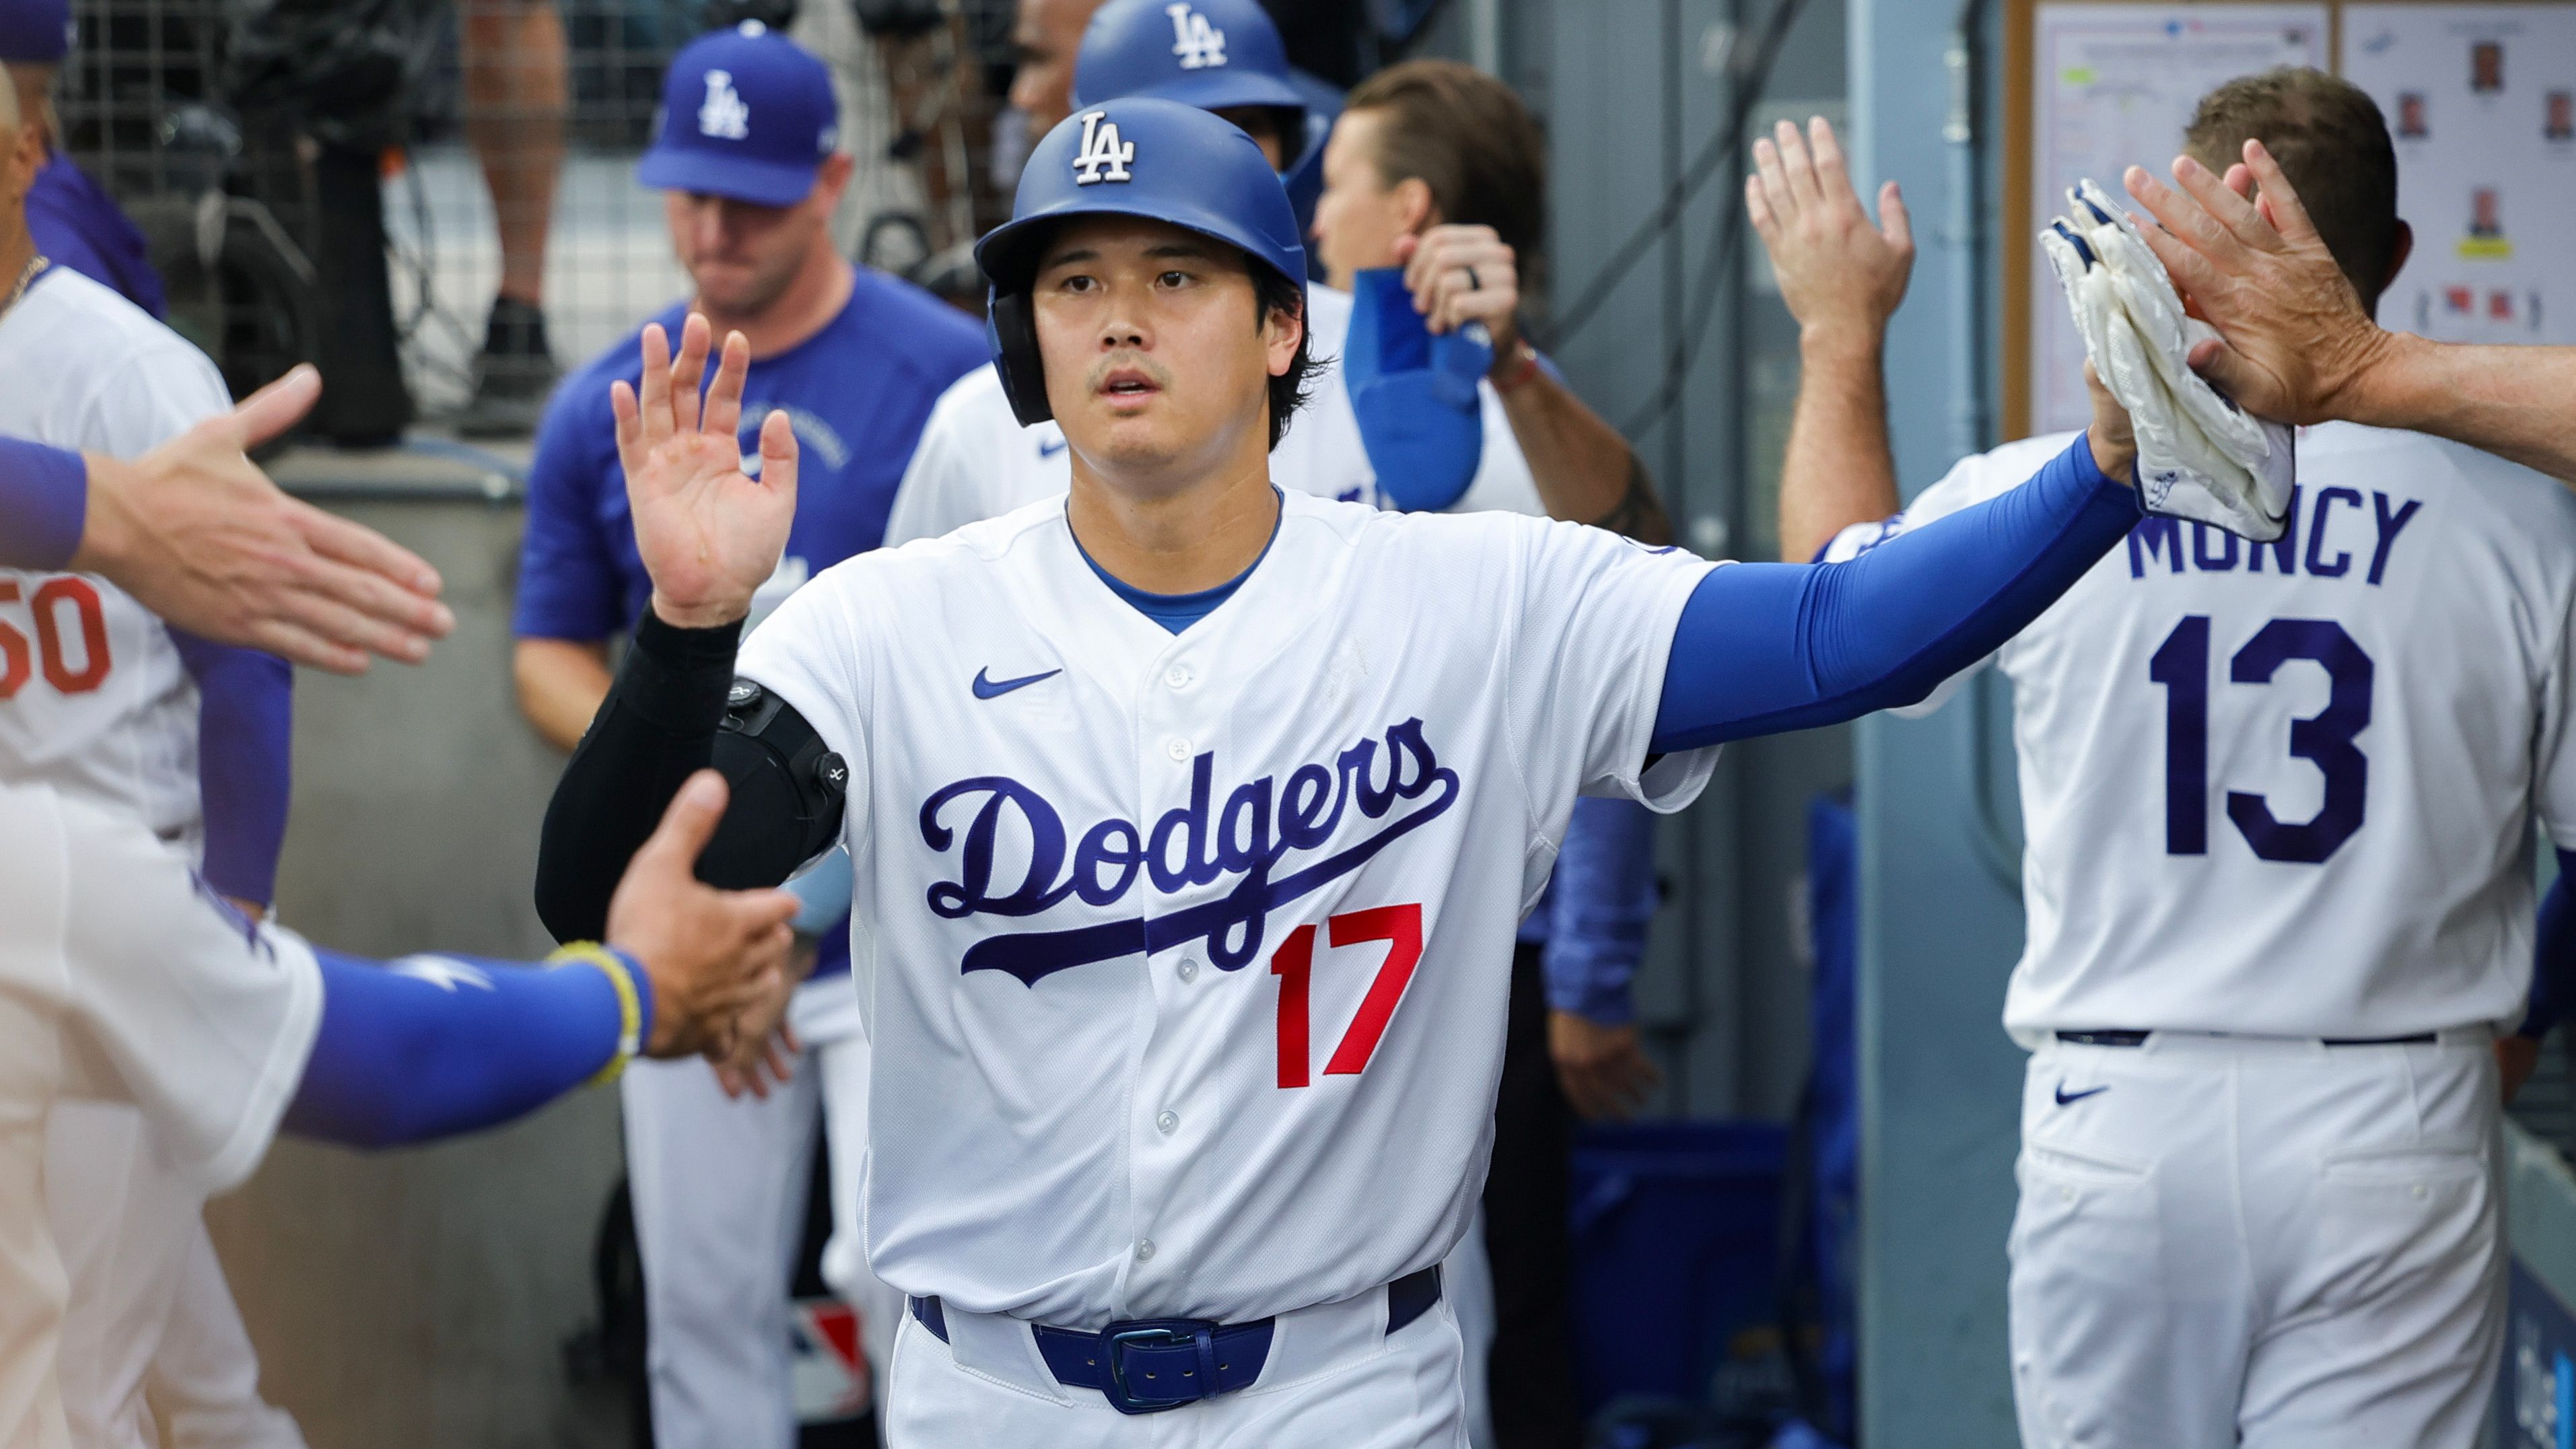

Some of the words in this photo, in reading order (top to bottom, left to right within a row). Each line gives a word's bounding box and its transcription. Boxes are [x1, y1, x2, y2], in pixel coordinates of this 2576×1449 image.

[1163, 1, 1228, 69] LA
[698, 68, 749, 140] LA
[1073, 110, 1135, 185] LA
[2128, 485, 2423, 585] MUNCY
[2149, 614, 2375, 865] 13
[919, 717, 1459, 973] Dodgers
[1270, 903, 1424, 1089] 17
